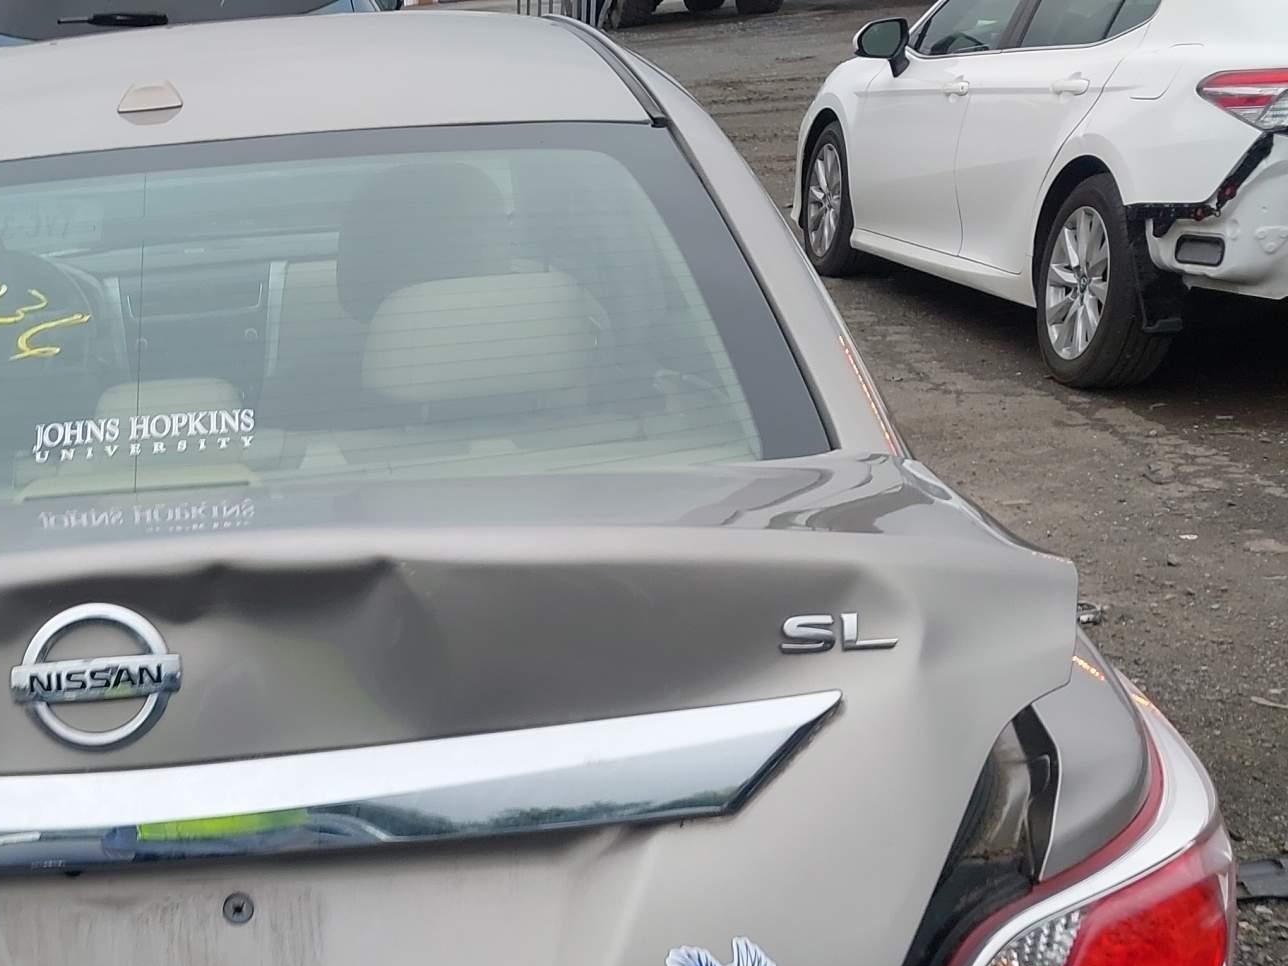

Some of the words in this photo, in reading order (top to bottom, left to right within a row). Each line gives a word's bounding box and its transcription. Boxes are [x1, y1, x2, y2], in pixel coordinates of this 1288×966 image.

[33, 417, 120, 454] JOHNS
[129, 408, 255, 441] HOPKINS
[34, 435, 255, 463] UNIVERSITY
[779, 612, 898, 654] SL
[28, 664, 163, 693] NISSAN
